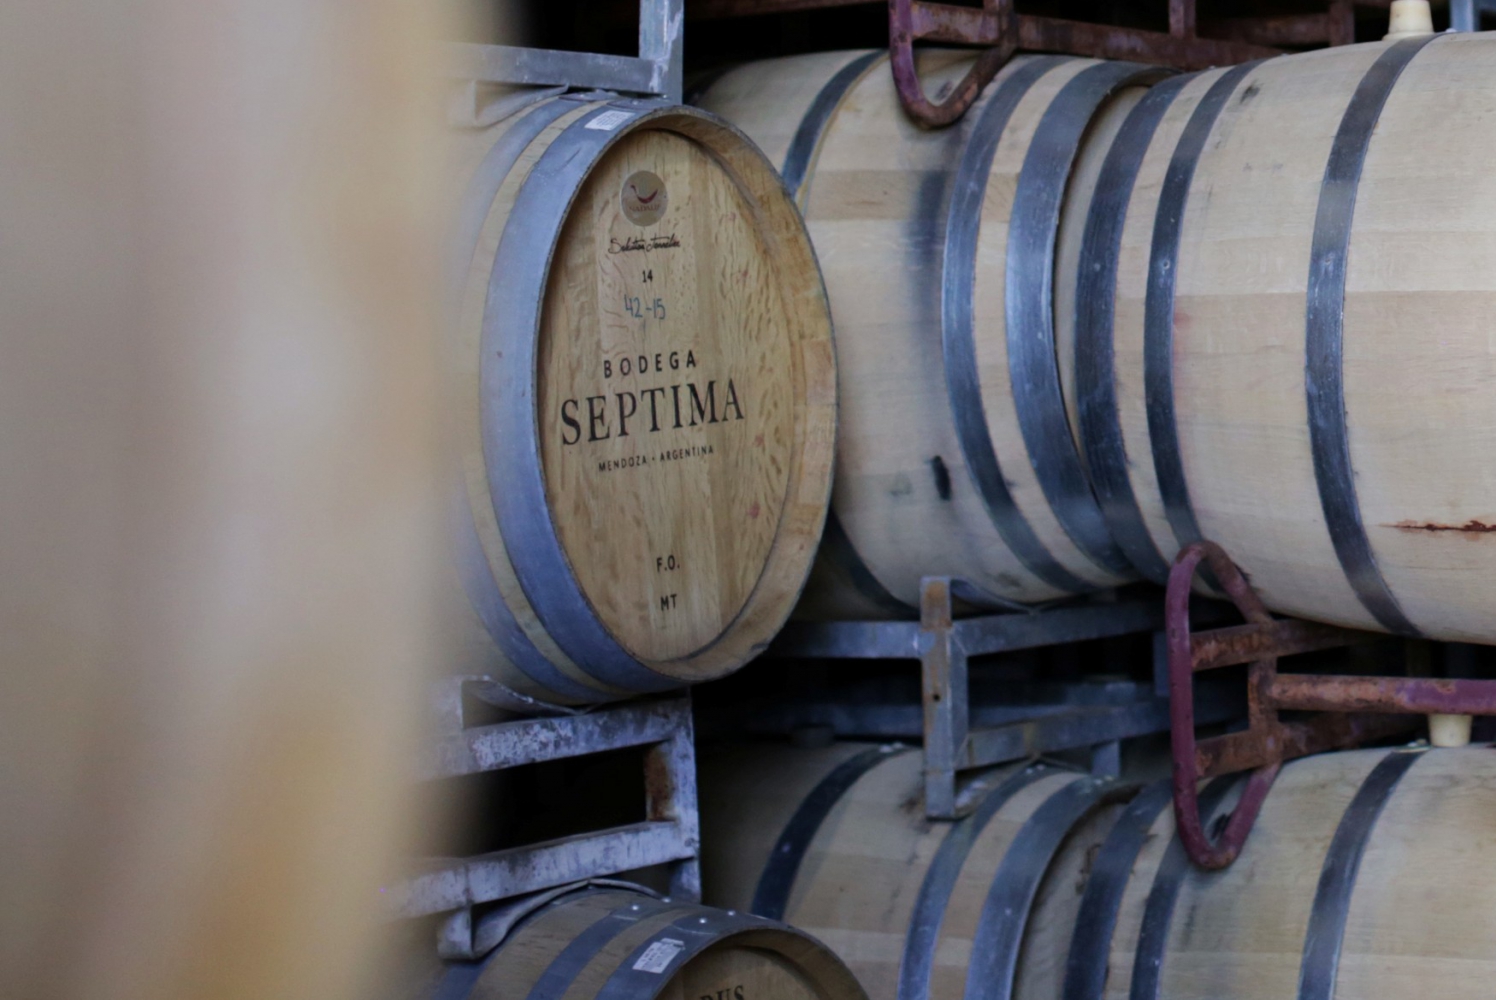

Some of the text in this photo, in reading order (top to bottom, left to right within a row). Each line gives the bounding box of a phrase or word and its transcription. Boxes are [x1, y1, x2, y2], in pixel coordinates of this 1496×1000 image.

[642, 269, 653, 283] 14
[624, 294, 666, 320] 42-15
[603, 350, 697, 379] BODEGA
[560, 378, 745, 446] SEPTIMA
[599, 445, 714, 472] MENDOZA ARGENTINA
[656, 554, 680, 573] F.O.
[660, 593, 677, 612] MT
